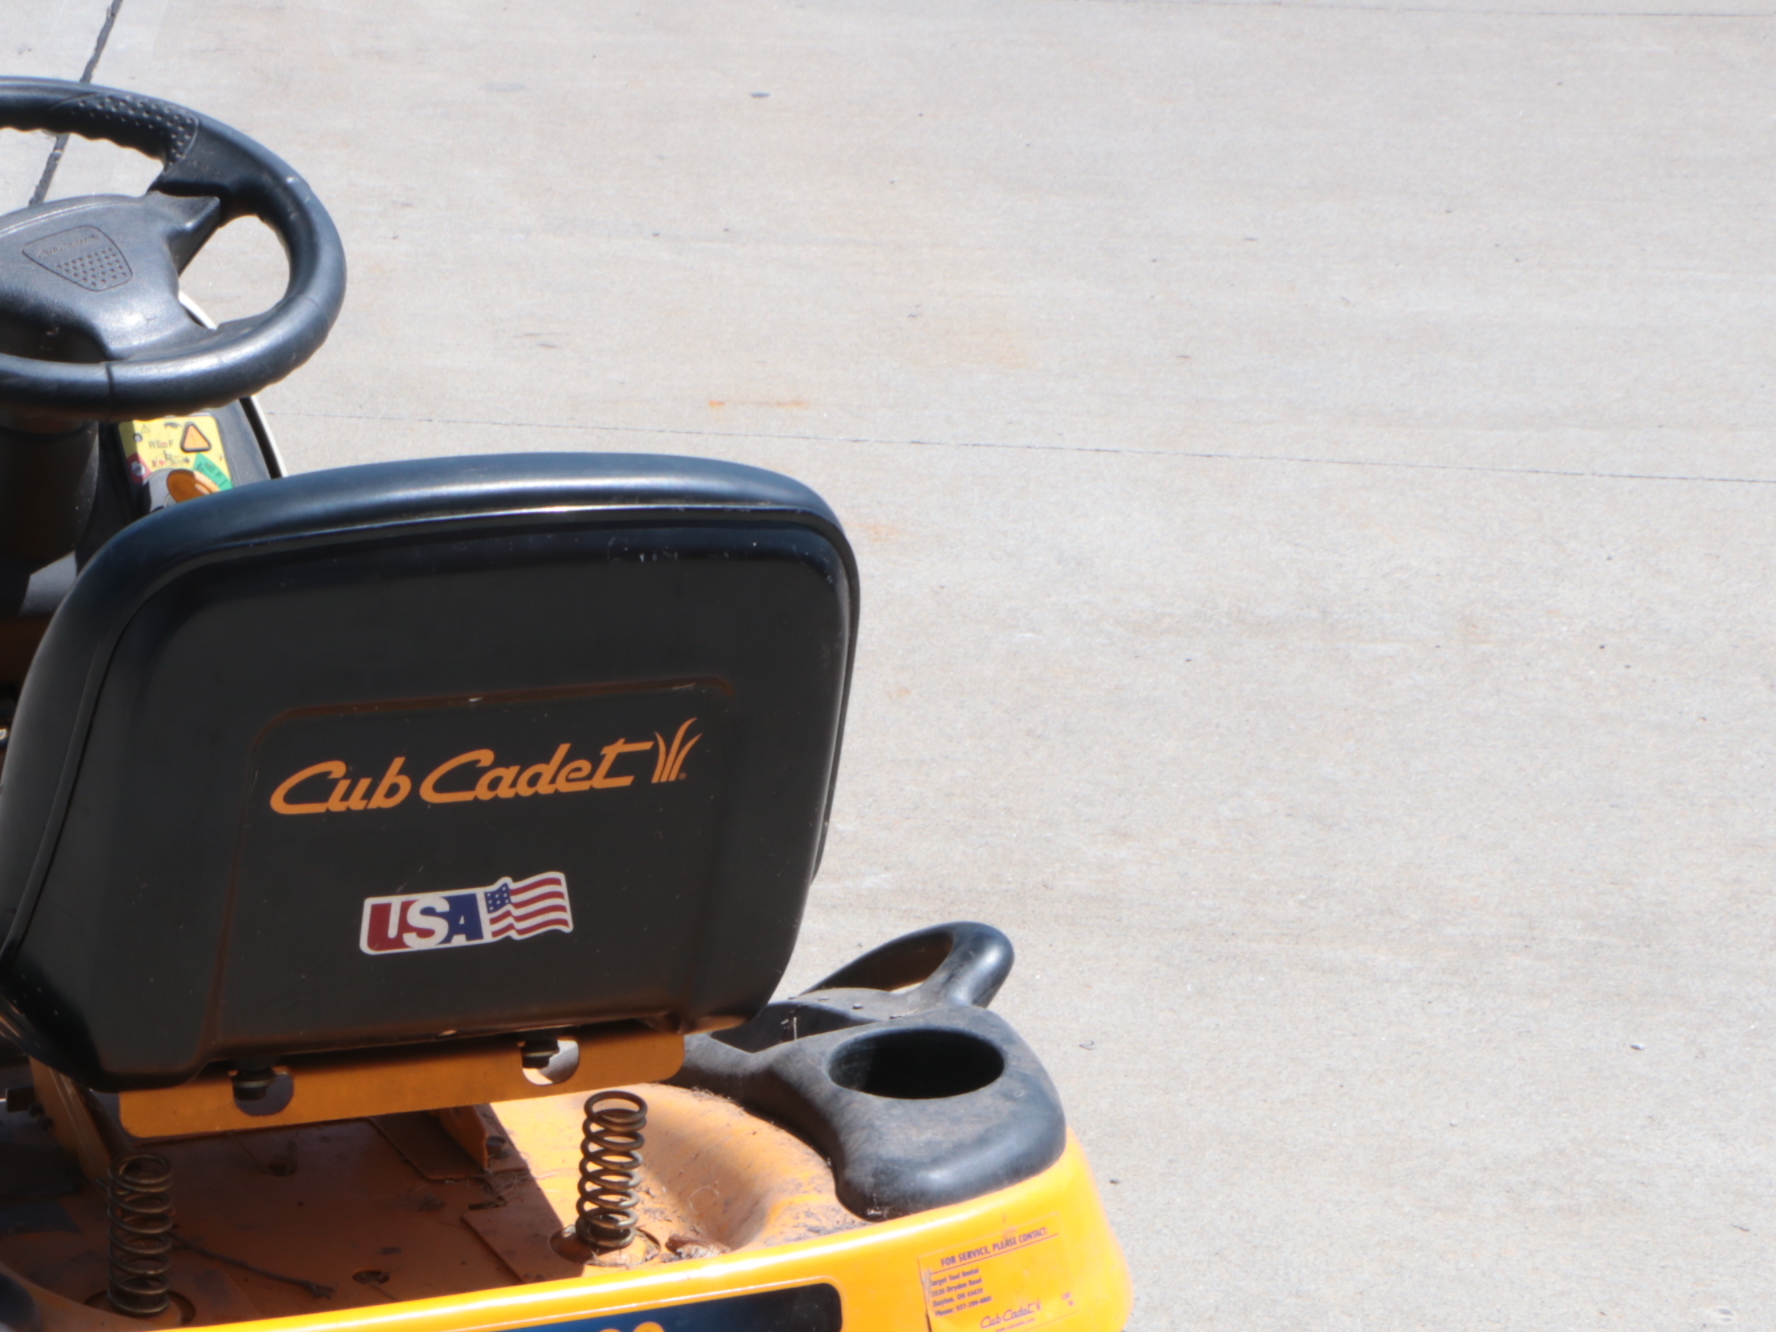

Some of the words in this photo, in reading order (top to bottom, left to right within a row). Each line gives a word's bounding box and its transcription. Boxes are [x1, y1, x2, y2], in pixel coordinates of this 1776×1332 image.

[270, 756, 412, 815] Cub
[419, 738, 654, 803] Cadet
[361, 890, 486, 954] USA
[941, 1256, 957, 1267] FOR
[992, 1236, 1018, 1252] PLEASE
[980, 1313, 1002, 1329] Cub
[1002, 1303, 1037, 1321] Cadet
